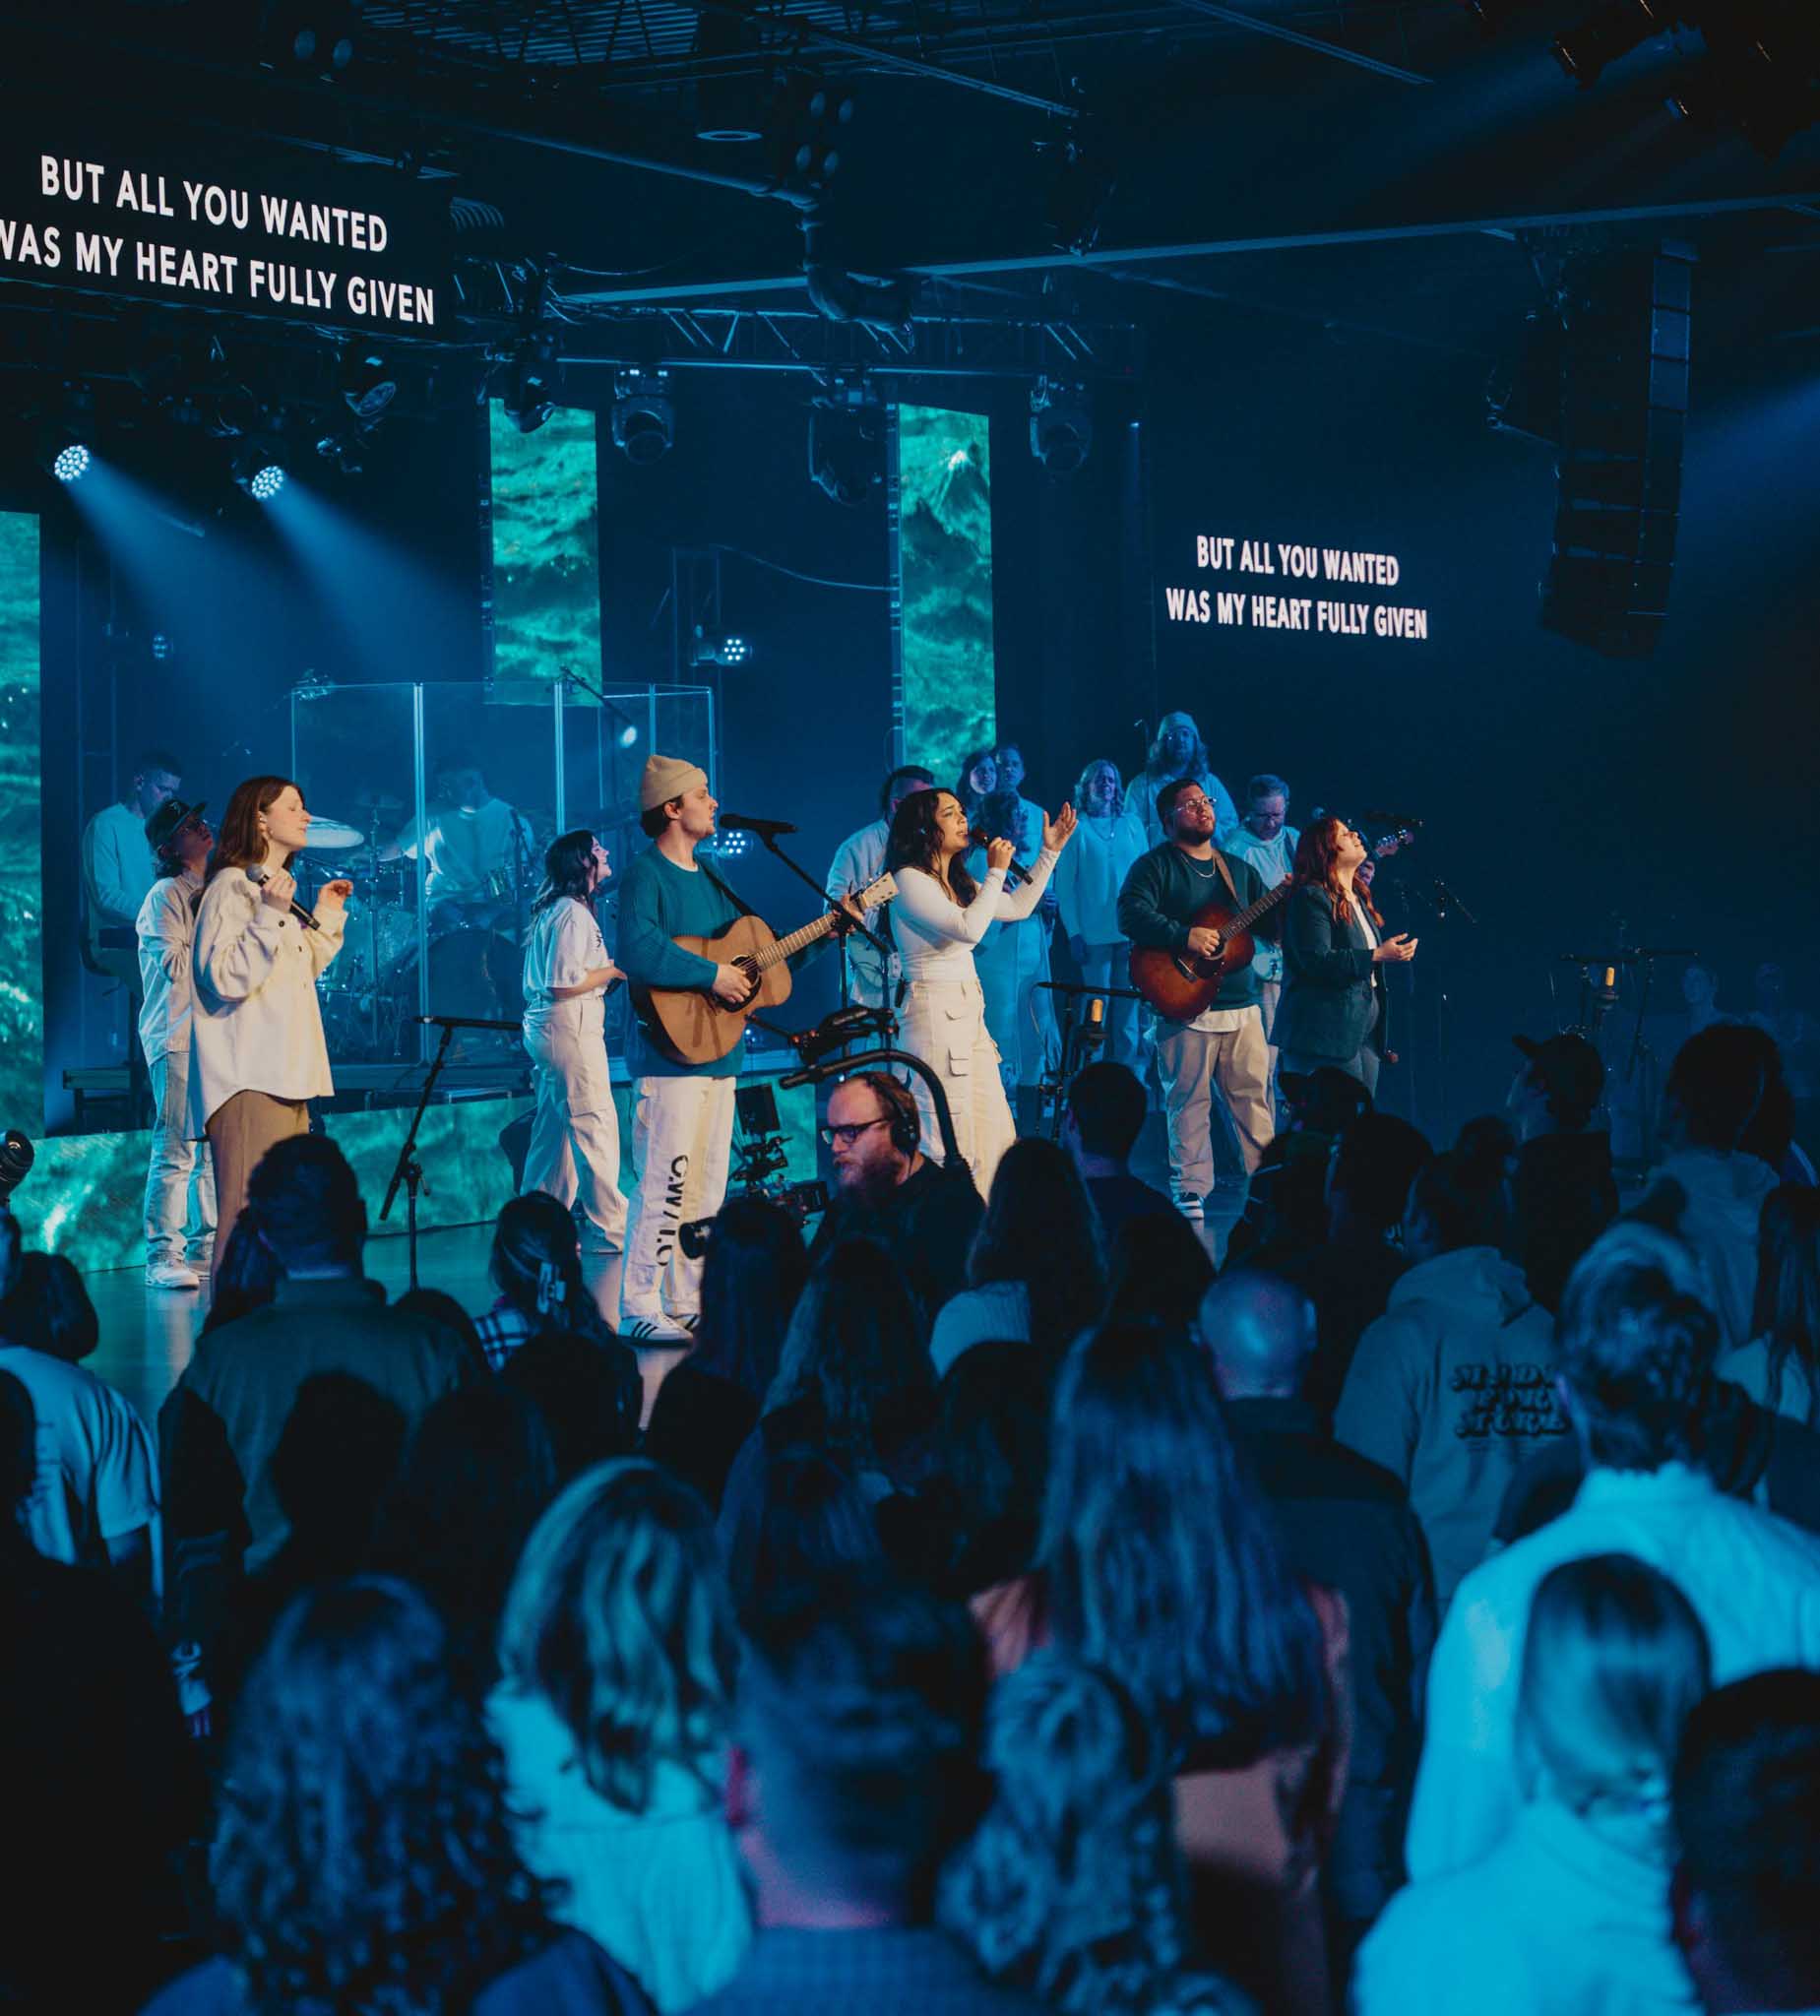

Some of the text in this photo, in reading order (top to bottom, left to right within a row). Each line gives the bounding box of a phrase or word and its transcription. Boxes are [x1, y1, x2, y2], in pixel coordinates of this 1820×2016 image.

[41, 155, 388, 252] BUT ALL YOU WANTED
[76, 231, 124, 277] MY
[137, 241, 238, 294] HEART
[250, 259, 338, 309] FULLY
[346, 276, 434, 325] GIVEN
[1196, 535, 1400, 586] BUT ALL YOU WANTED
[1165, 587, 1427, 640] WAS MY HEART FULLY GIVEN
